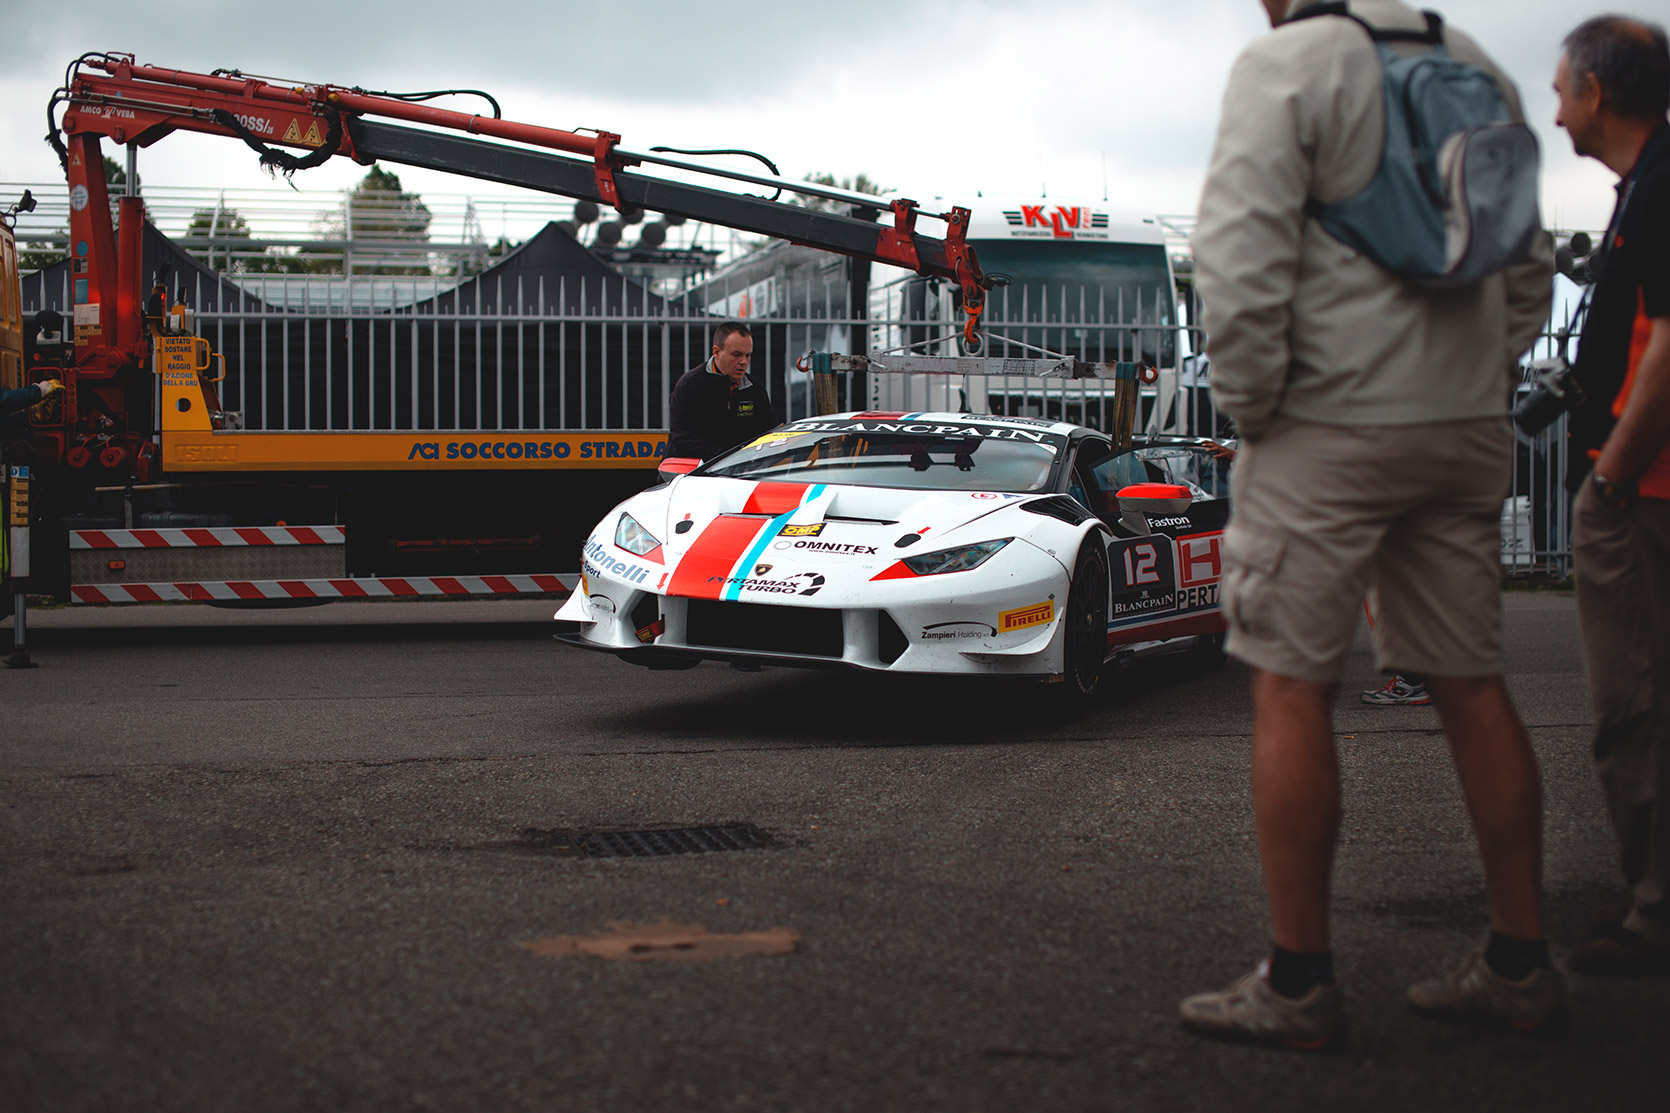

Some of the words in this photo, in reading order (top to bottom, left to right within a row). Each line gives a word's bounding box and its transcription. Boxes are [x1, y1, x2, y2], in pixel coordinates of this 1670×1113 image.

[80, 105, 102, 114] AMCO
[116, 109, 135, 119] VEBA
[1020, 205, 1080, 240] KLV
[782, 422, 1050, 443] BLANCPAIN
[446, 441, 571, 460] SOCCORSO
[783, 525, 821, 535] OMP
[1147, 516, 1191, 529] Fastron
[794, 540, 879, 555] OMNITEX
[1123, 543, 1160, 587] 12
[707, 576, 801, 589] PERTAMAX
[738, 584, 797, 595] TURBO
[1114, 593, 1174, 614] BLANCPAIN
[1005, 604, 1051, 629] PIRELLI
[921, 631, 956, 640] Zampieri
[957, 631, 982, 639] Holding
